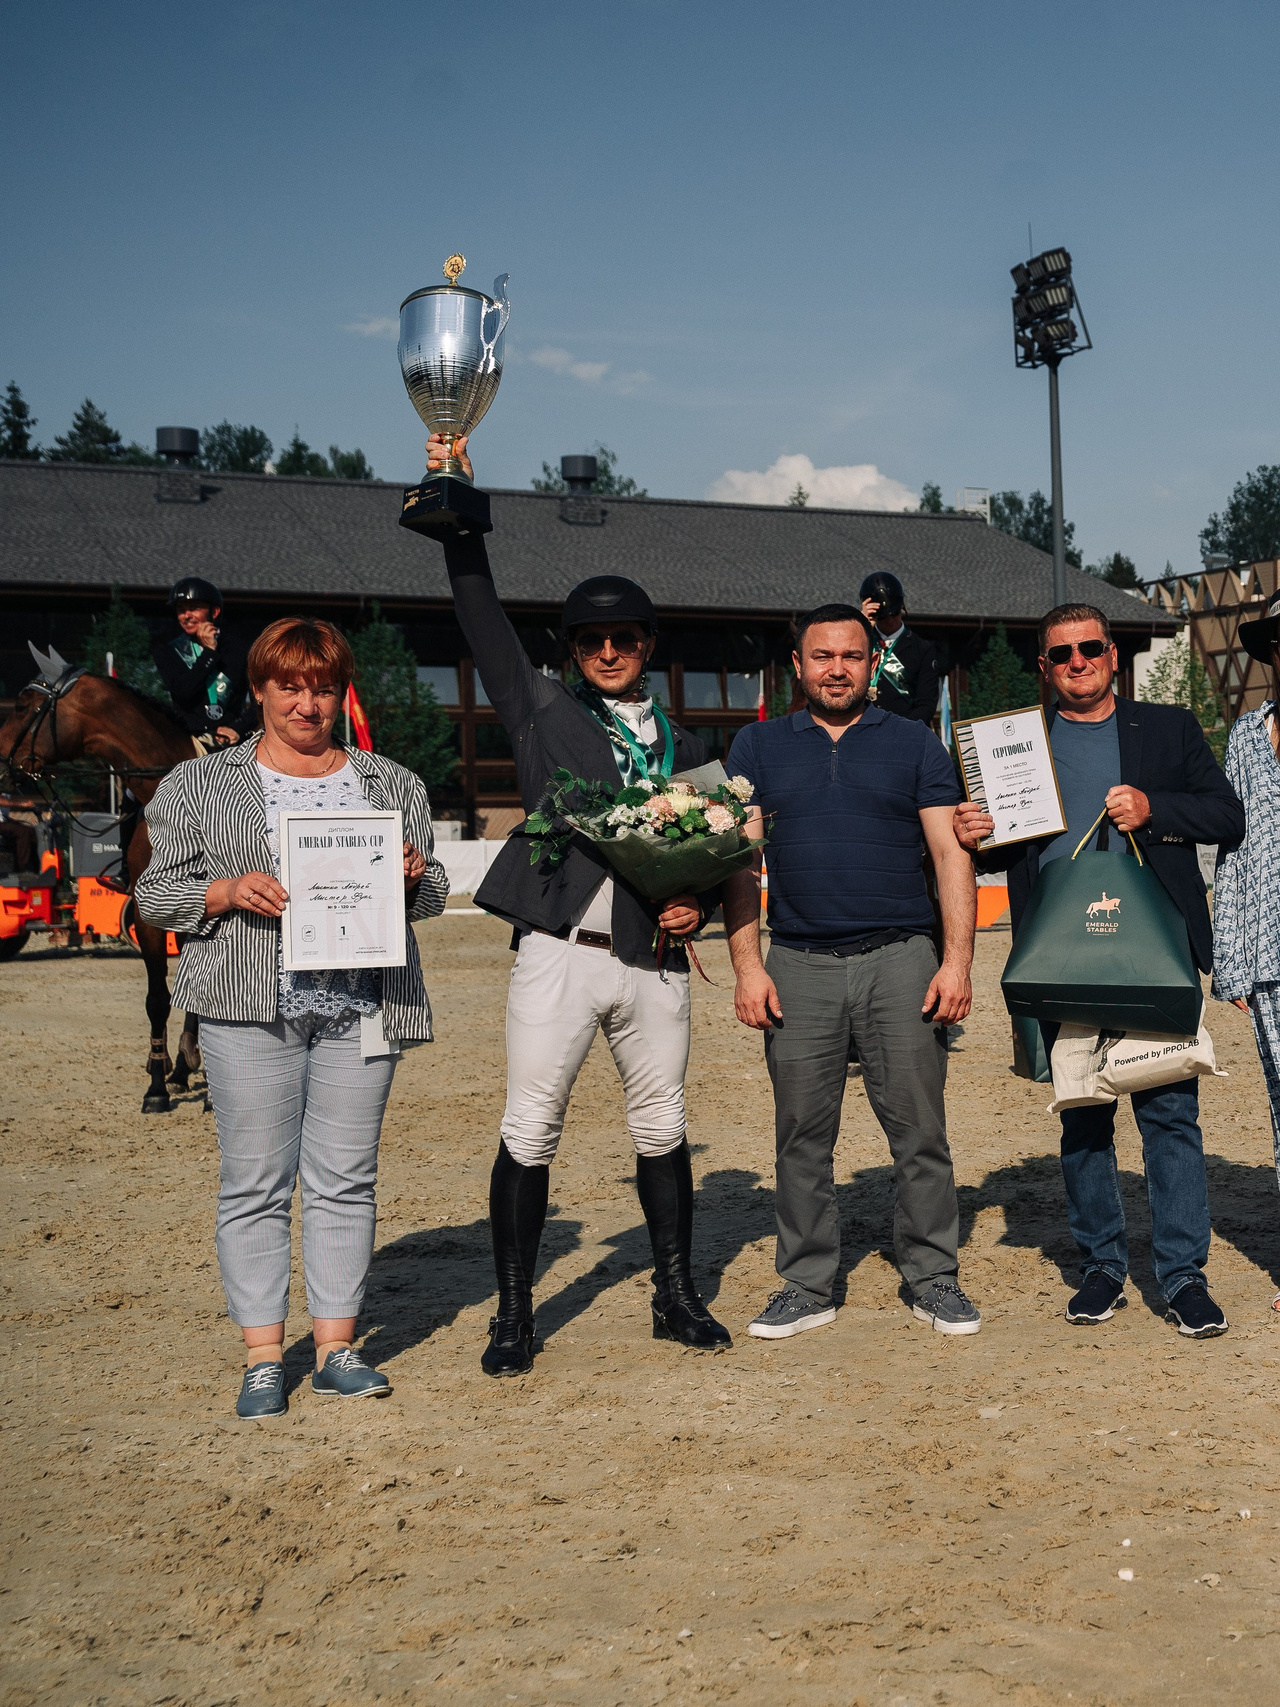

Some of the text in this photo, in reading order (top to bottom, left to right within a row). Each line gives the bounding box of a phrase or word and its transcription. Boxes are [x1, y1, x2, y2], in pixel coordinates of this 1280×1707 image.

[992, 740, 1034, 760] СЕРТИФИКАТ
[961, 746, 986, 794] STABLES
[298, 834, 384, 849] EMERALD STABLES CUP
[340, 925, 346, 936] 1
[1113, 1038, 1200, 1067] Powered by IPPOLAB
